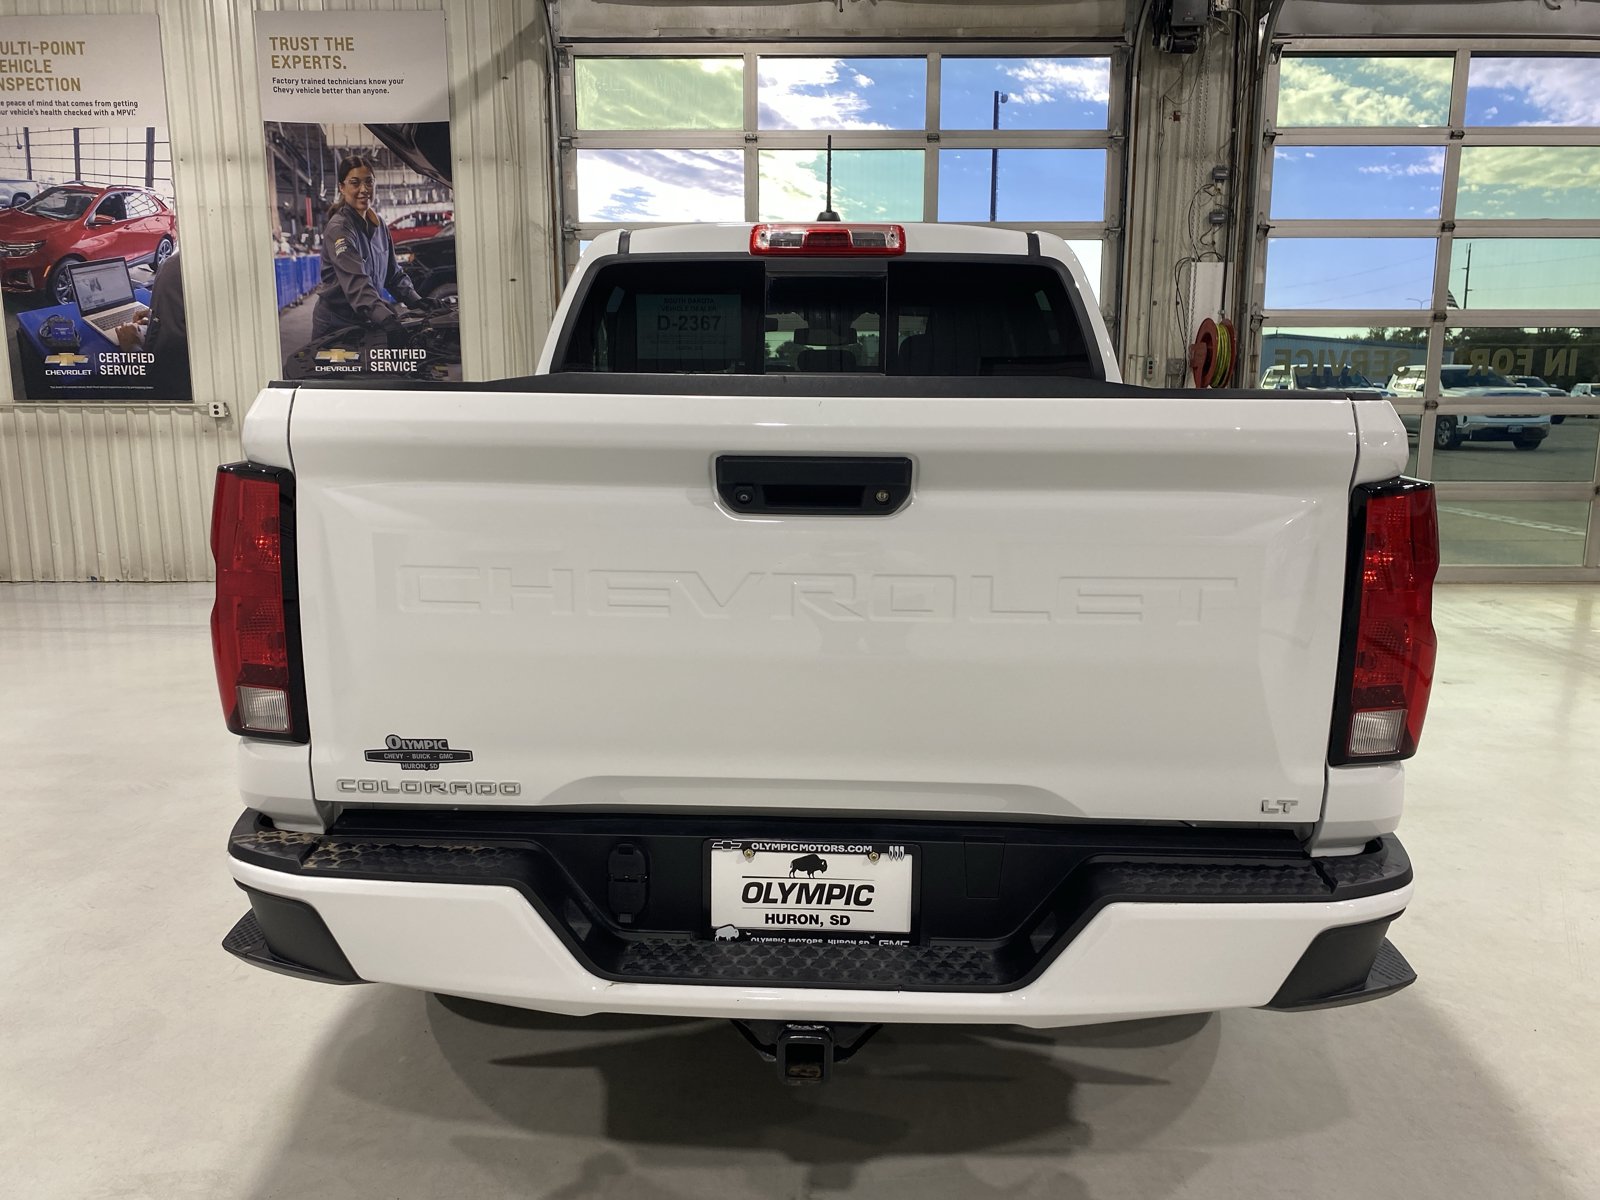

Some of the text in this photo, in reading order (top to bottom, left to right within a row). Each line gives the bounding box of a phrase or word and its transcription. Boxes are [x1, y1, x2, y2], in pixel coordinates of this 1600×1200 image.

[0, 41, 85, 55] ULTI-POINT
[269, 36, 355, 51] TRUST THE
[0, 59, 52, 73] EHICLE
[271, 55, 347, 70] EXPERTS.
[0, 77, 81, 91] NSPECTION
[272, 77, 299, 86] Factory
[273, 86, 294, 95] Chevy
[362, 88, 390, 96] anyone.
[6, 100, 26, 108] peace
[112, 99, 139, 108] getting
[657, 315, 722, 331] D-2367
[98, 352, 155, 363] CERTIFIED
[369, 349, 426, 360] CERTIFIED
[99, 365, 146, 375] SERVICE
[370, 361, 417, 372] SERVICE
[397, 564, 1238, 624] CHEVROLET
[336, 779, 522, 795] COLORADO
[1261, 799, 1299, 814] LT
[741, 882, 875, 907] OLYMPIC
[764, 913, 851, 928] HURON, SD
[878, 939, 910, 948] GMC
